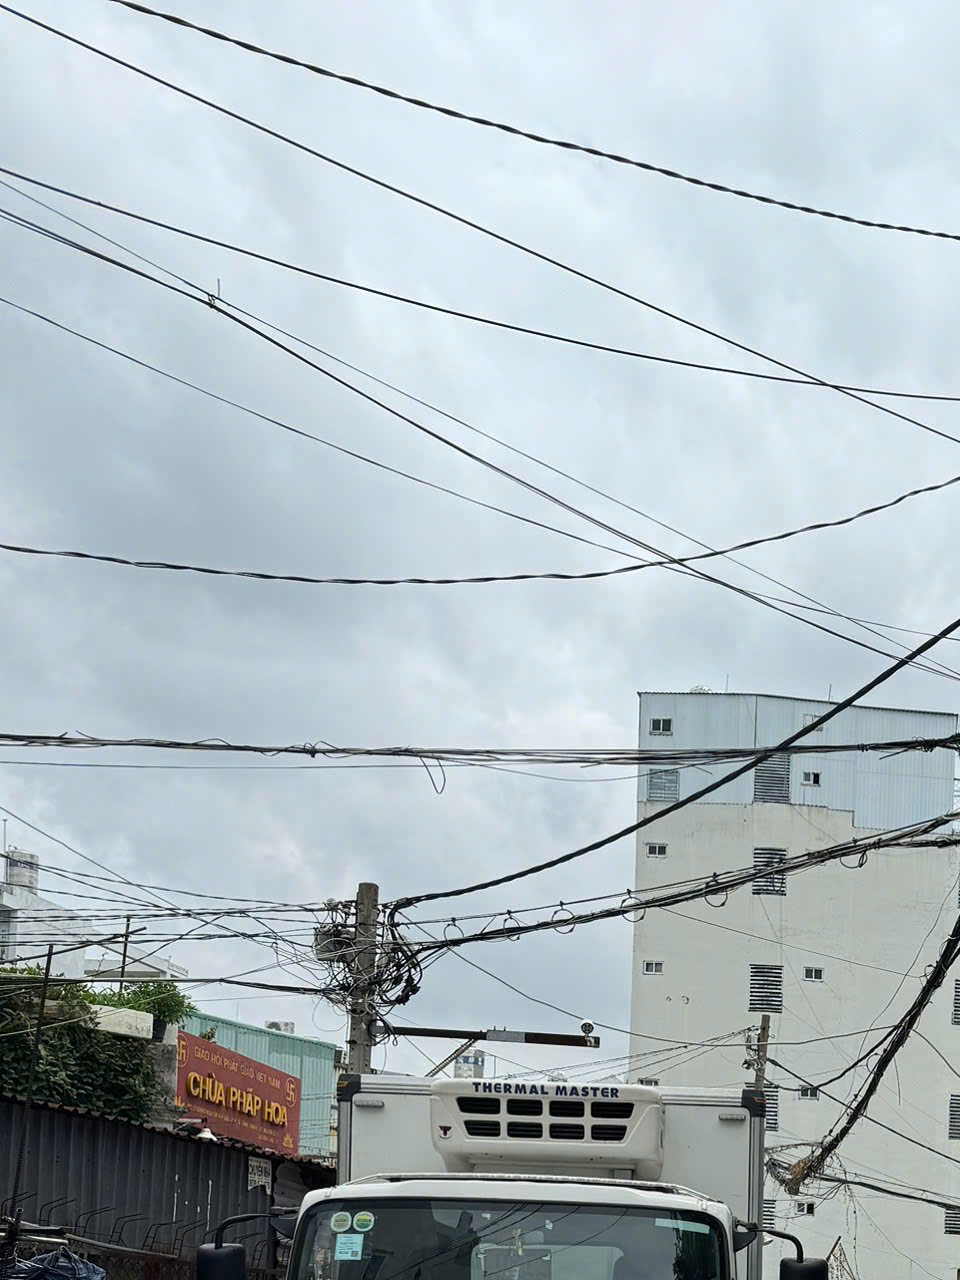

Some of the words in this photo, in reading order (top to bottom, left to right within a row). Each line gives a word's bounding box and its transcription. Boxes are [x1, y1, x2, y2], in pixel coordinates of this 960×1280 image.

[472, 1081, 549, 1096] THERMAL
[555, 1085, 620, 1098] MASTER
[264, 1099, 289, 1127] HOA
